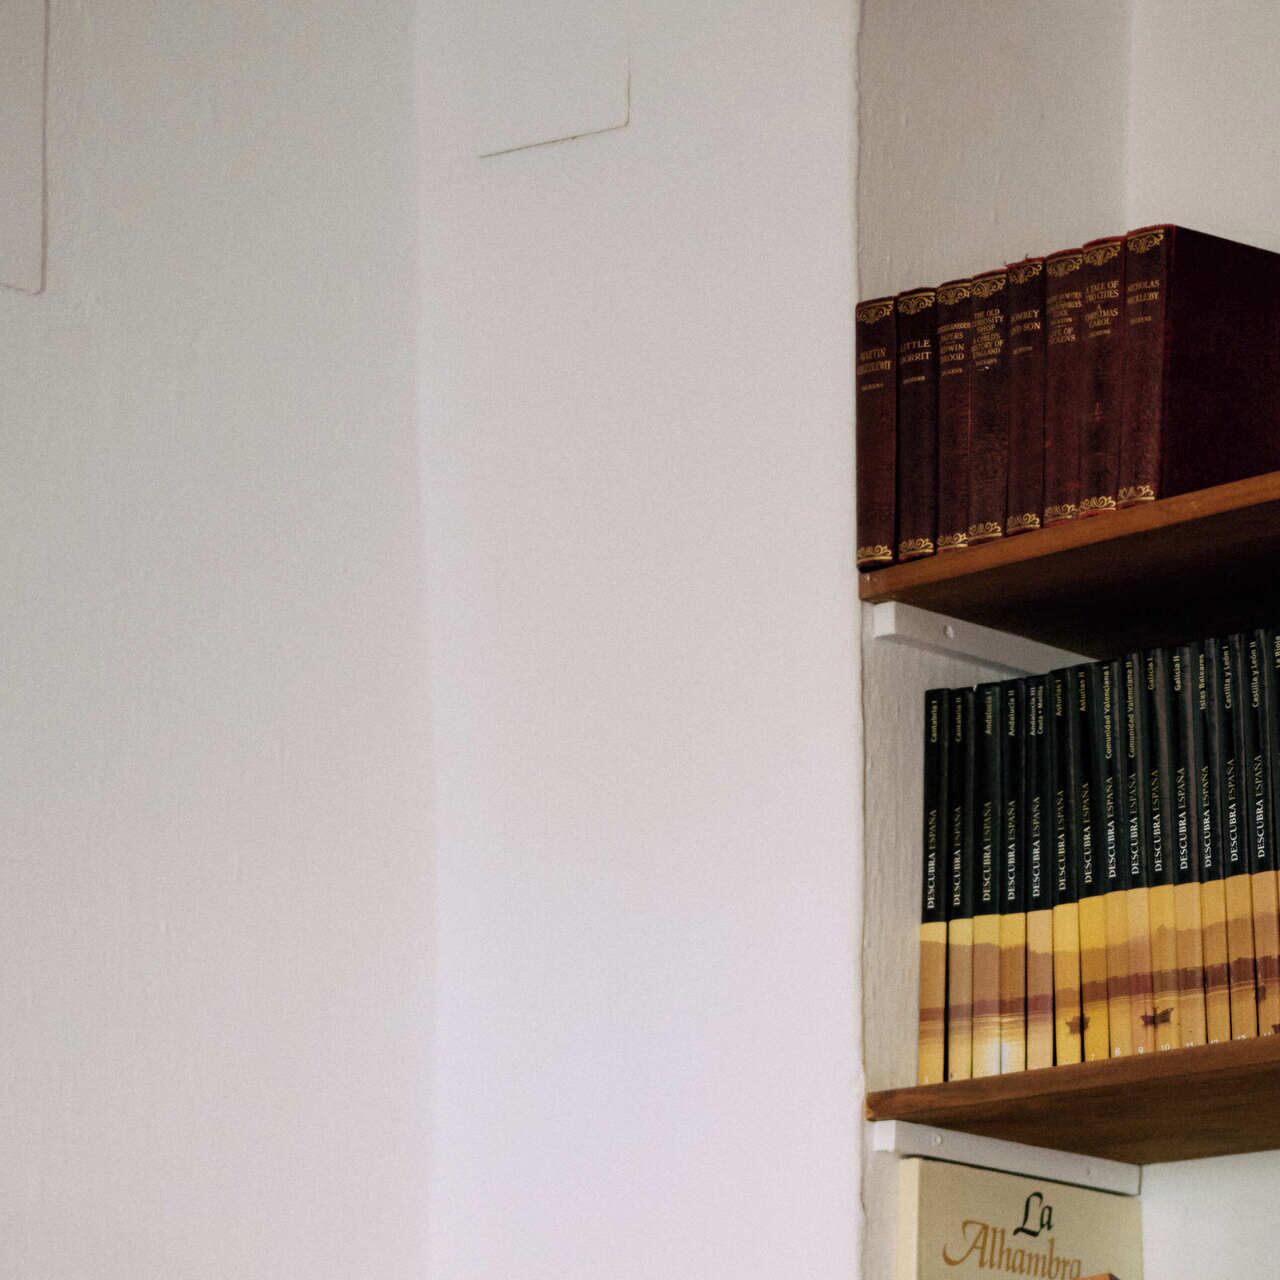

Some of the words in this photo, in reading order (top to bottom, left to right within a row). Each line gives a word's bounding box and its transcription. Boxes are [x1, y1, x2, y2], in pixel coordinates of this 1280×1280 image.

[1223, 679, 1232, 709] Castilla
[1225, 759, 1237, 801] ESPAÑA
[1006, 801, 1016, 840] ESPAÑA
[1229, 804, 1239, 862] DESCUBRA
[1007, 843, 1016, 900] DESCUBRA
[1013, 1192, 1053, 1237] La
